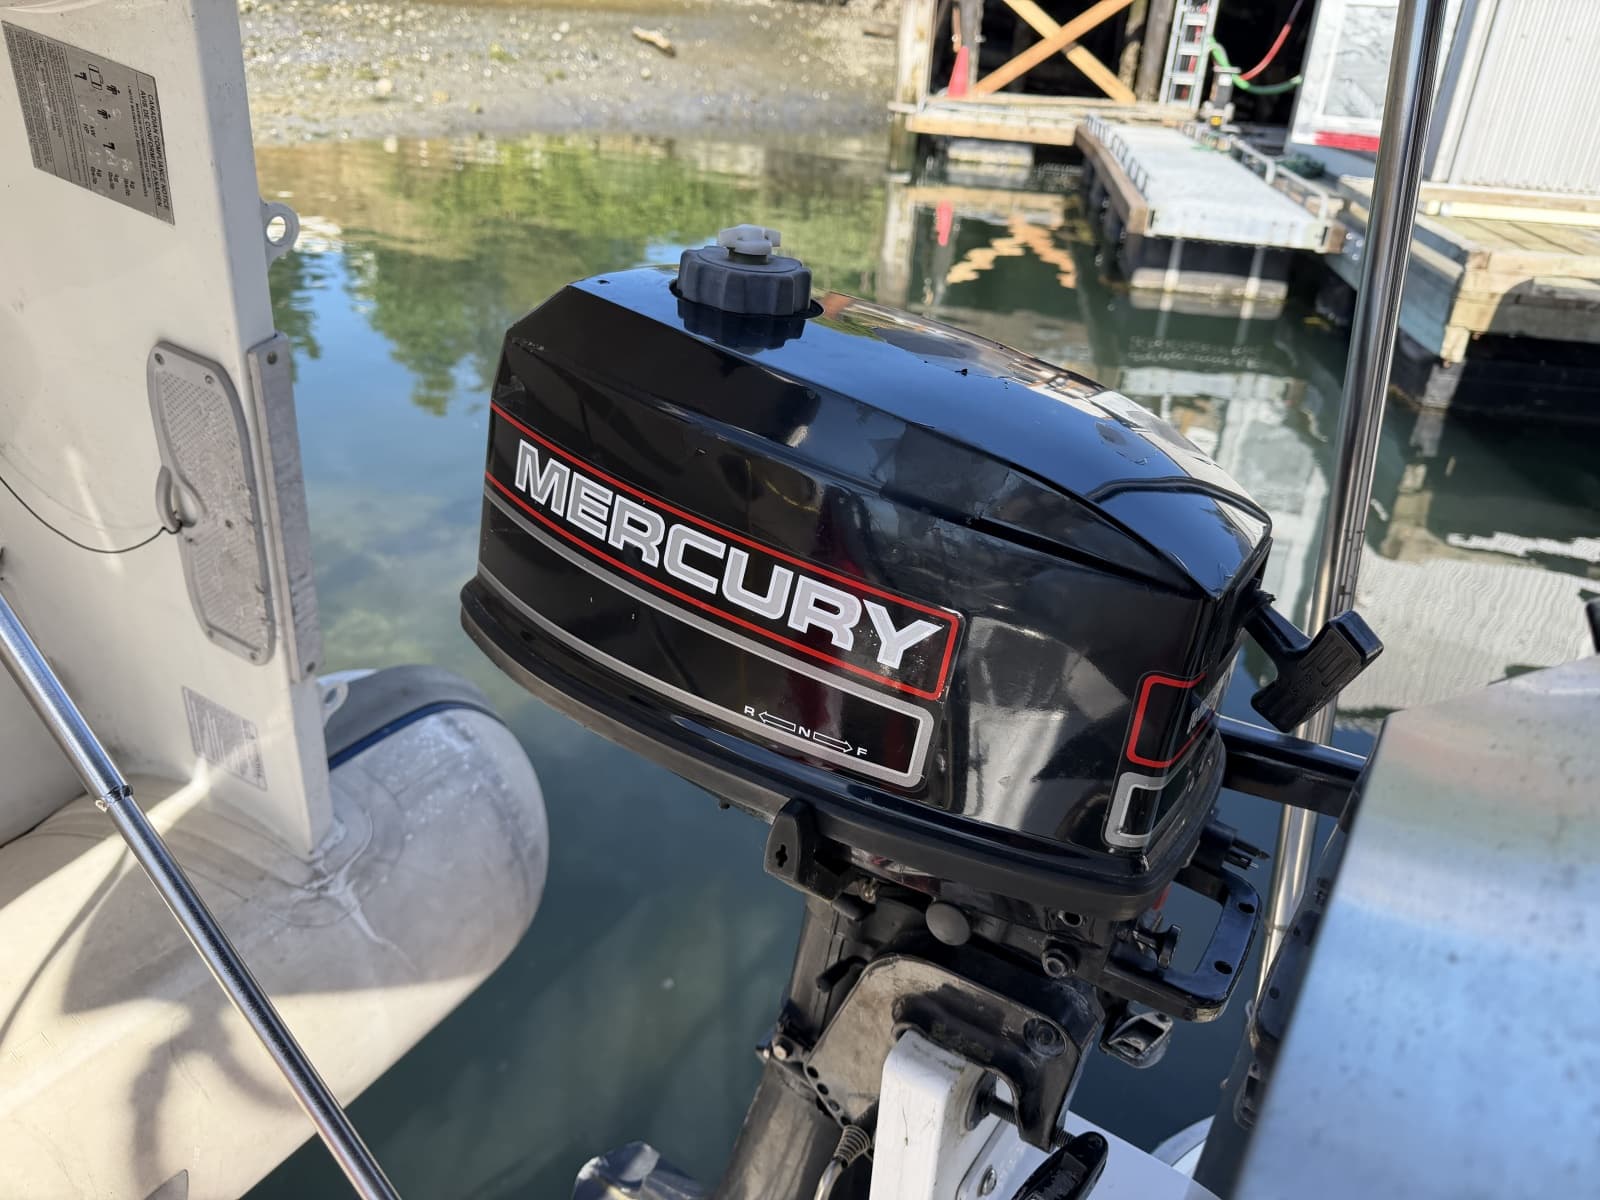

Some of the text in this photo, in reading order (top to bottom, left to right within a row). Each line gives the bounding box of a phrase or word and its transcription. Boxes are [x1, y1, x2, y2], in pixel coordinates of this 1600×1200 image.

[143, 109, 149, 120] DE
[152, 170, 162, 207] CANADIEN
[148, 94, 169, 209] CANADIAN COMPLIANCE NOTICE
[515, 439, 942, 669] MERCURY
[744, 705, 868, 757] R N F
